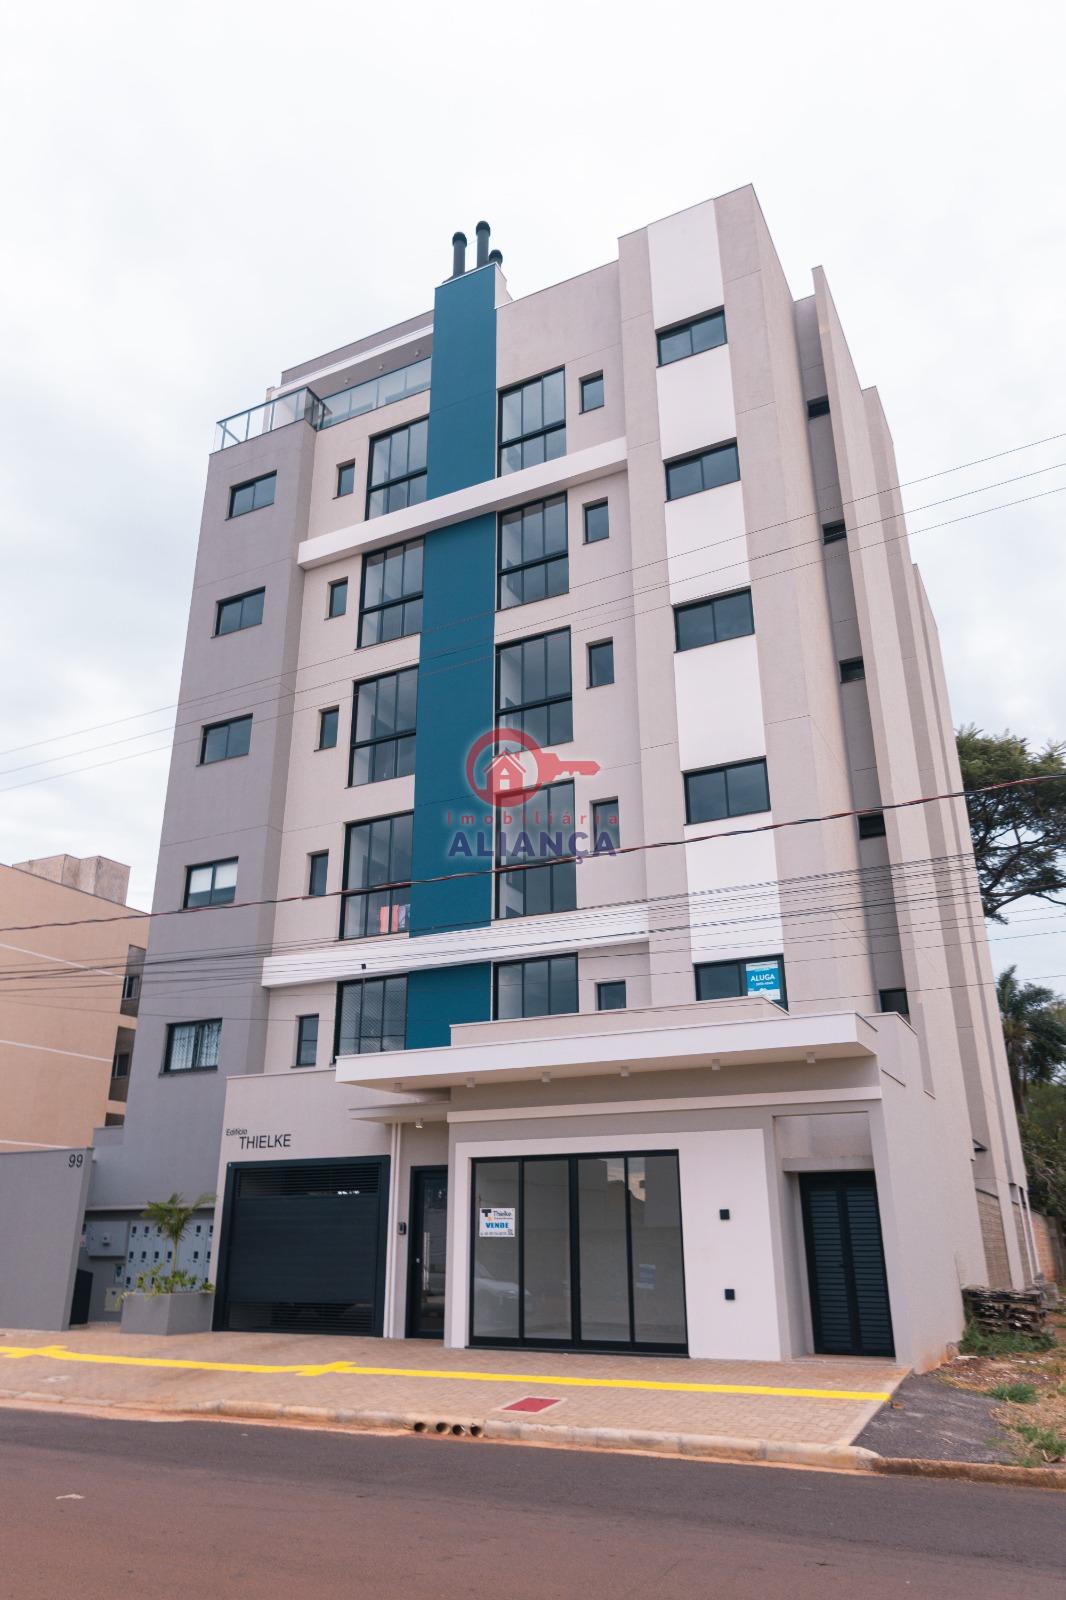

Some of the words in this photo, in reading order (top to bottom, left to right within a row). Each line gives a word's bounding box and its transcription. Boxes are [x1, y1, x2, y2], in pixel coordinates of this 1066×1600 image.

[751, 973, 775, 982] ALUGA
[239, 1134, 292, 1149] THIELKE
[69, 1154, 83, 1168] 99
